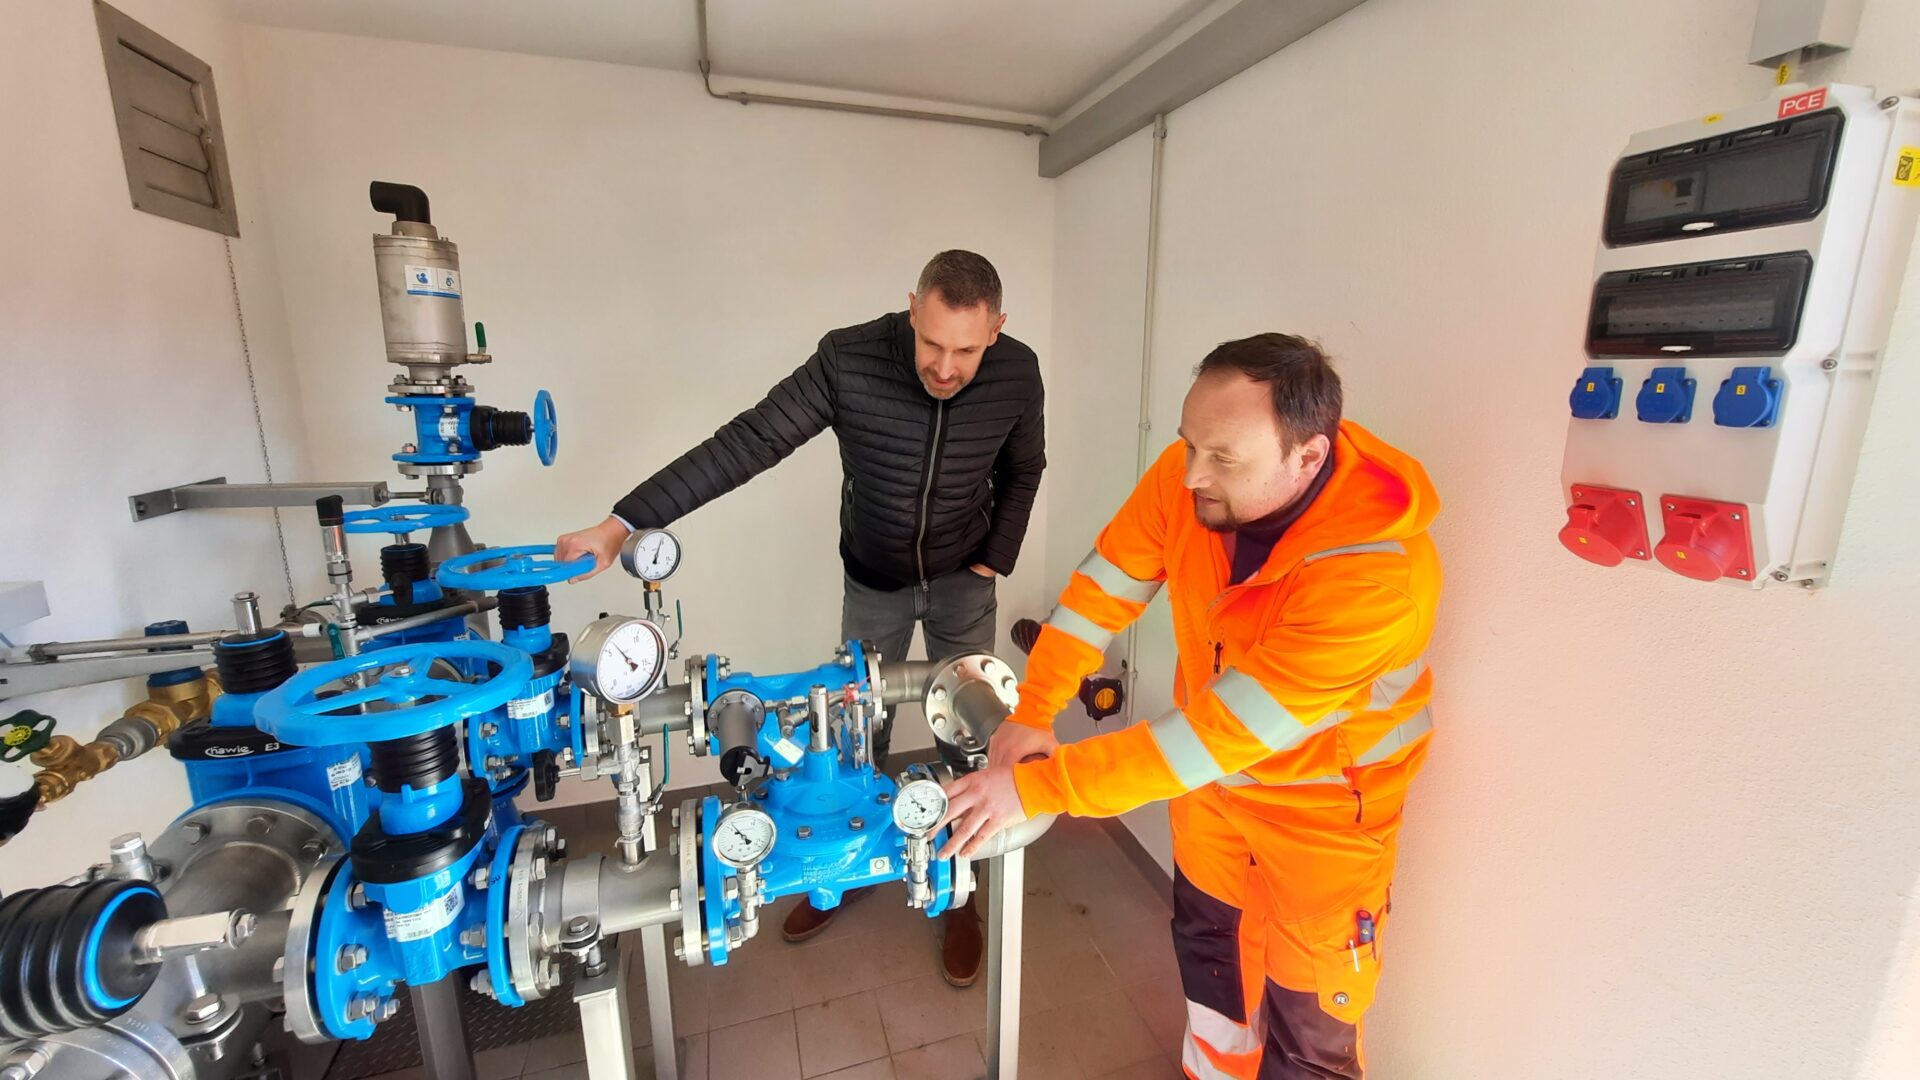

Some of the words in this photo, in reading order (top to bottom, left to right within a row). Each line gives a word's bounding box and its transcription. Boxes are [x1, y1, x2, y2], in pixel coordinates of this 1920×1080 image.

[1782, 92, 1823, 115] PCE
[206, 745, 252, 757] hawle
[264, 742, 280, 752] E3
